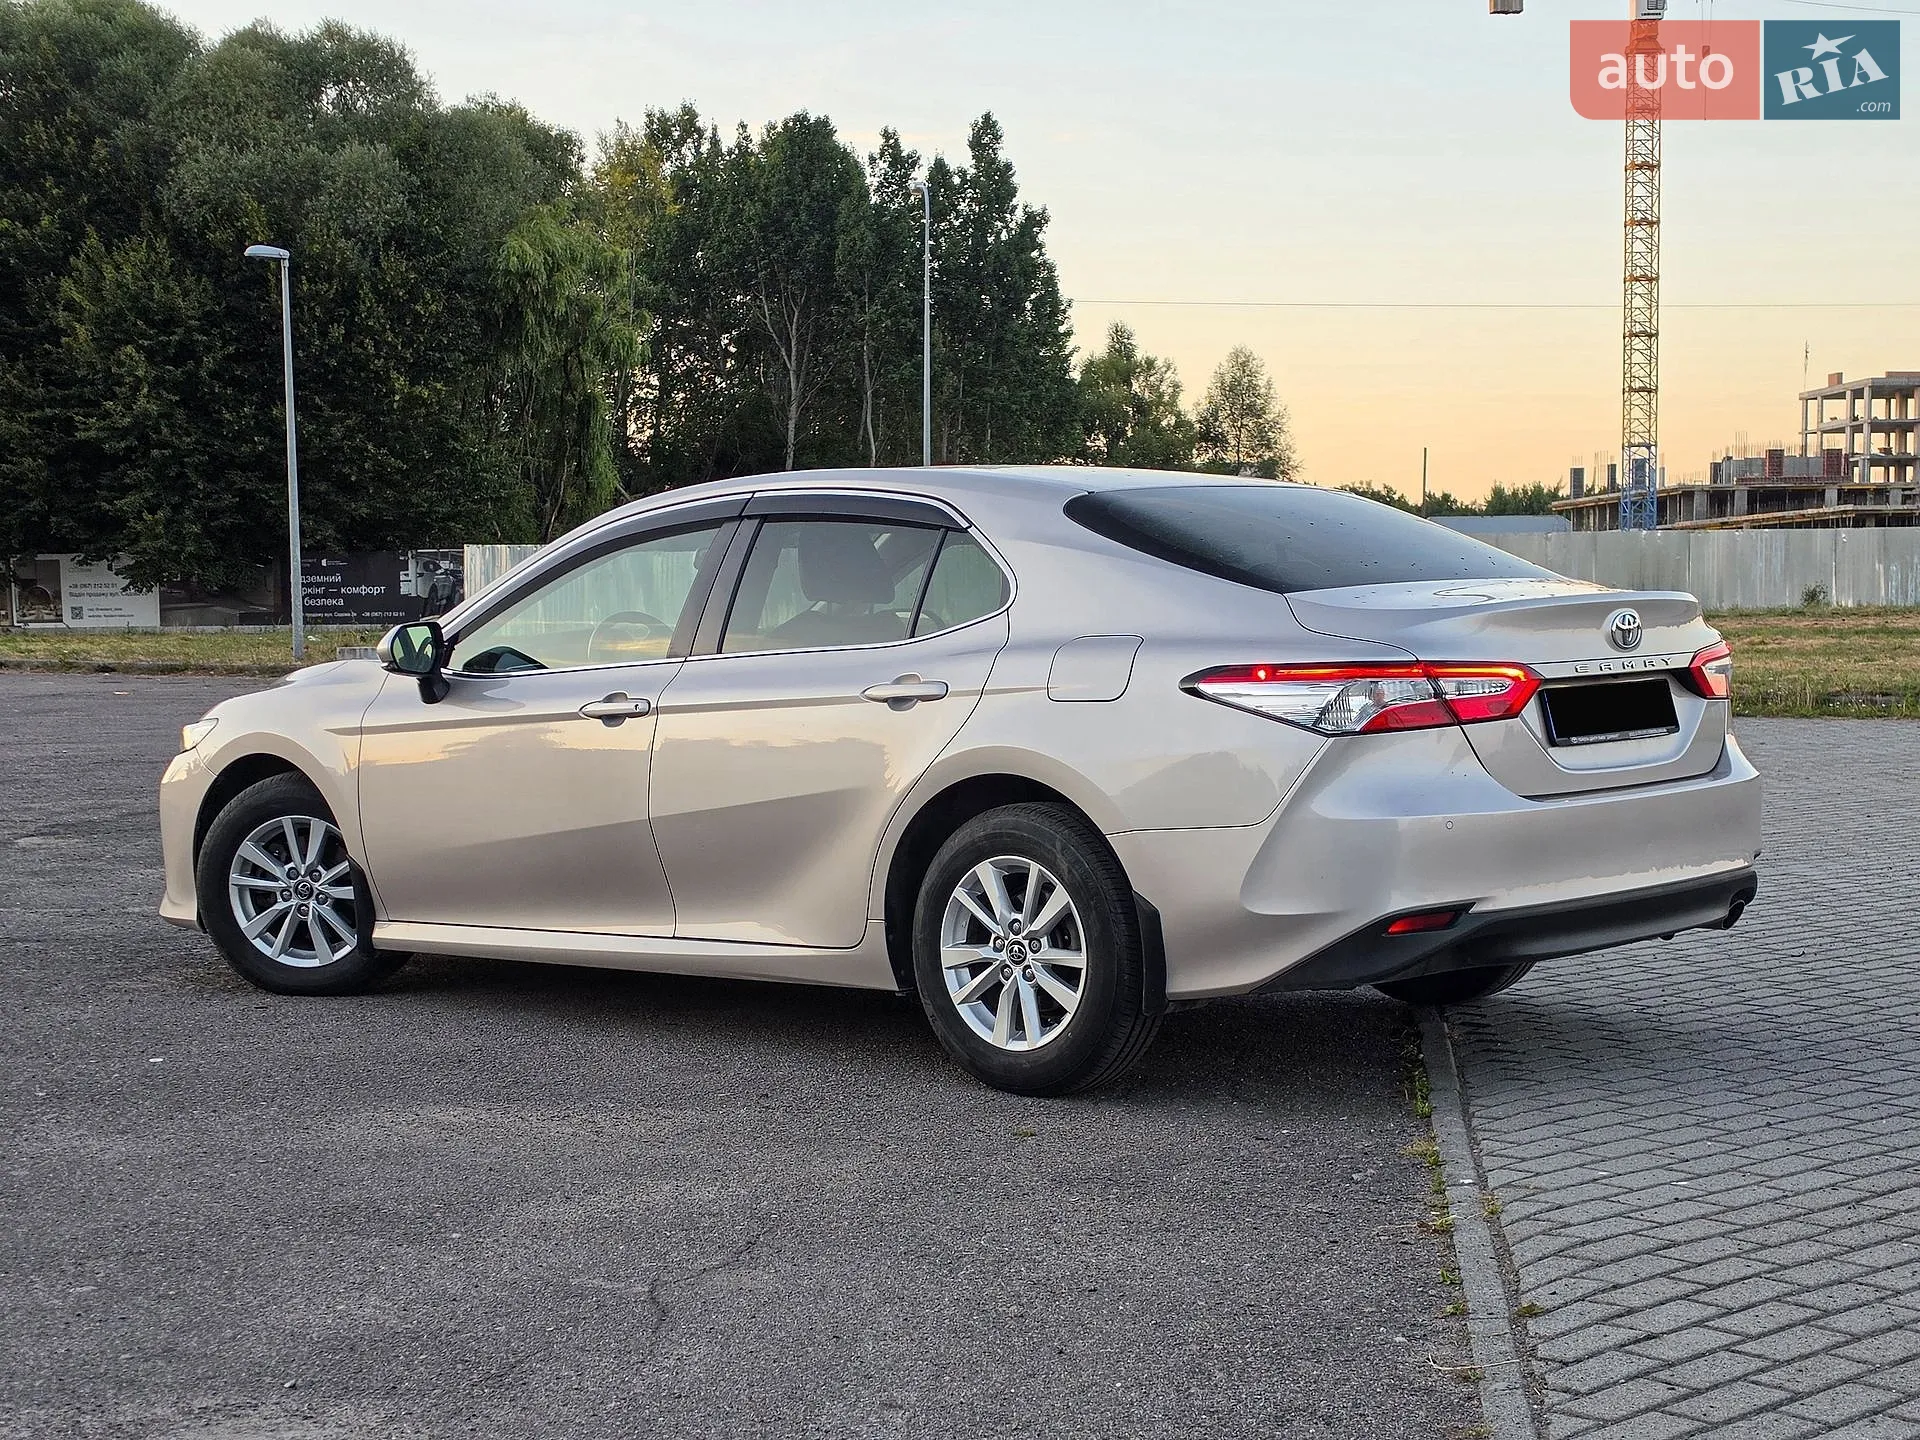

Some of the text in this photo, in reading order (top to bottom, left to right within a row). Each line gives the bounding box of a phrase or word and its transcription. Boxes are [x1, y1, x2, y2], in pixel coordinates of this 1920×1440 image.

[300, 573, 341, 583] дземний
[301, 586, 325, 595] ркінг
[341, 585, 386, 596] комфорт
[304, 597, 344, 606] безпека
[1575, 657, 1673, 674] CAMRY
